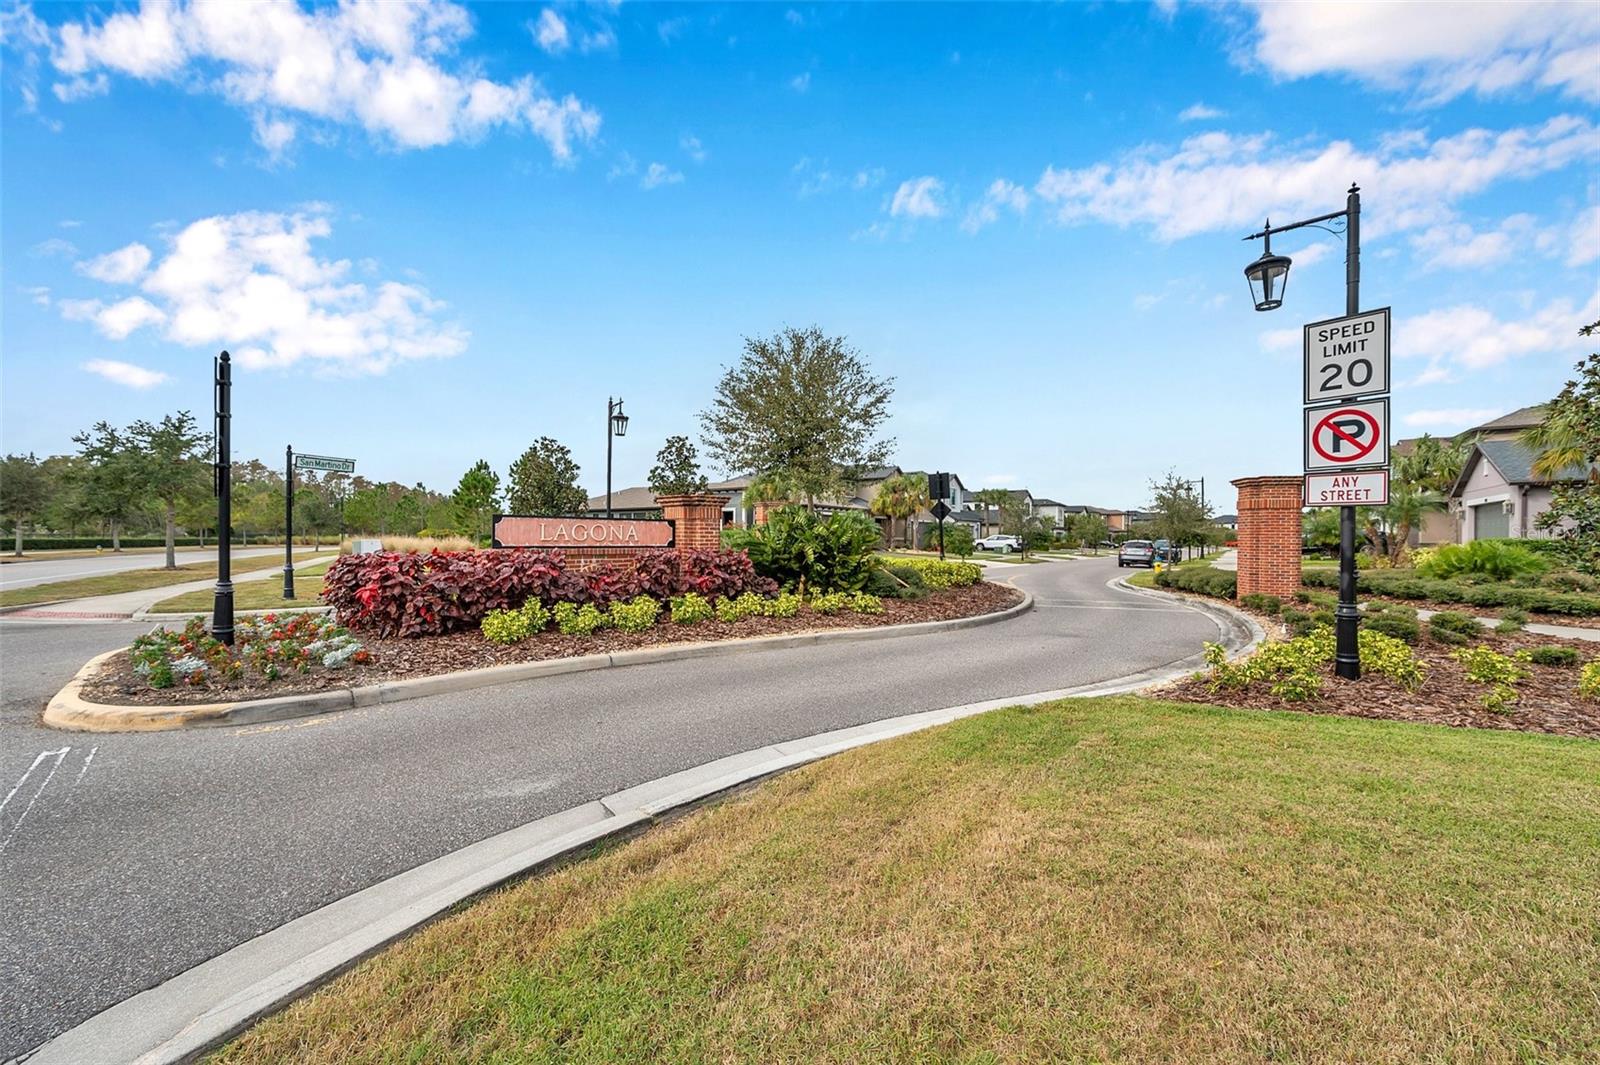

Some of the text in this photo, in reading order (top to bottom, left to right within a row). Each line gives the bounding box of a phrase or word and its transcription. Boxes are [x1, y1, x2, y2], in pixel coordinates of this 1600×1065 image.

[1318, 320, 1375, 342] SPEED
[1323, 338, 1368, 358] LIMIT
[1320, 358, 1373, 392] 20
[1333, 419, 1366, 453] P
[300, 459, 314, 467] San
[315, 460, 341, 470] Martino
[1332, 476, 1359, 488] ANY
[1320, 489, 1371, 501] STREET
[539, 522, 639, 542] LAGONA
